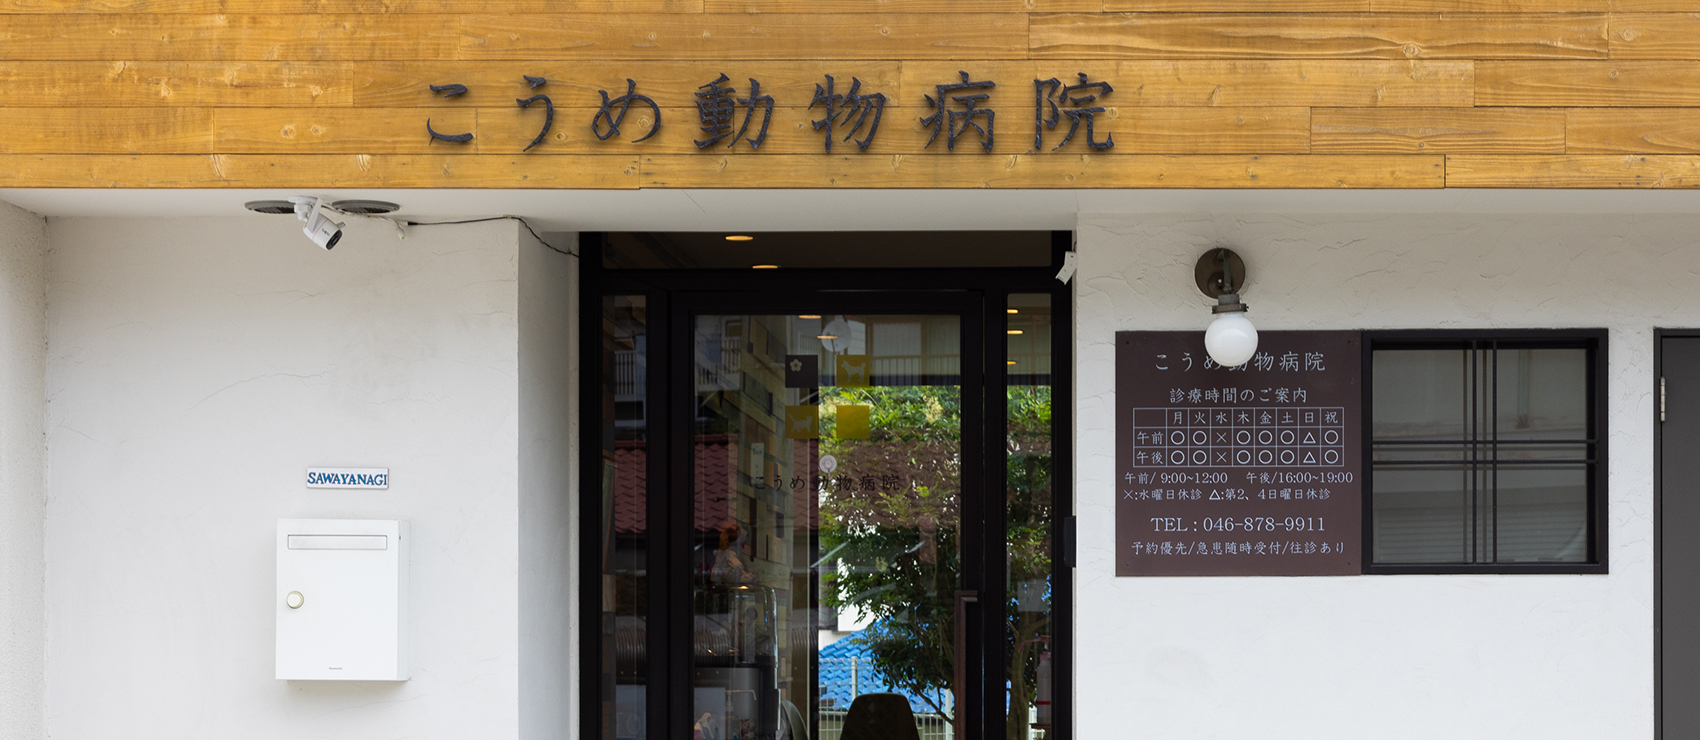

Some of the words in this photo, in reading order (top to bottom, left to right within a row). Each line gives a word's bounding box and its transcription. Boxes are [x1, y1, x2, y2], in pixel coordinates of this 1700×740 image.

[427, 71, 1115, 153] こうめ動物病院
[1169, 387, 1307, 404] 診療時間のご案内
[1173, 411, 1182, 424] 月
[1194, 411, 1206, 424] 火
[1215, 411, 1228, 424] 水
[1237, 411, 1250, 424] 木
[1259, 411, 1272, 424] 金
[1281, 411, 1294, 424] 土
[1305, 411, 1314, 424] 日
[1325, 411, 1338, 424] 祝
[1137, 431, 1164, 445] 午前
[1136, 450, 1164, 464] 午後
[307, 472, 387, 486] SAWAYANAGI
